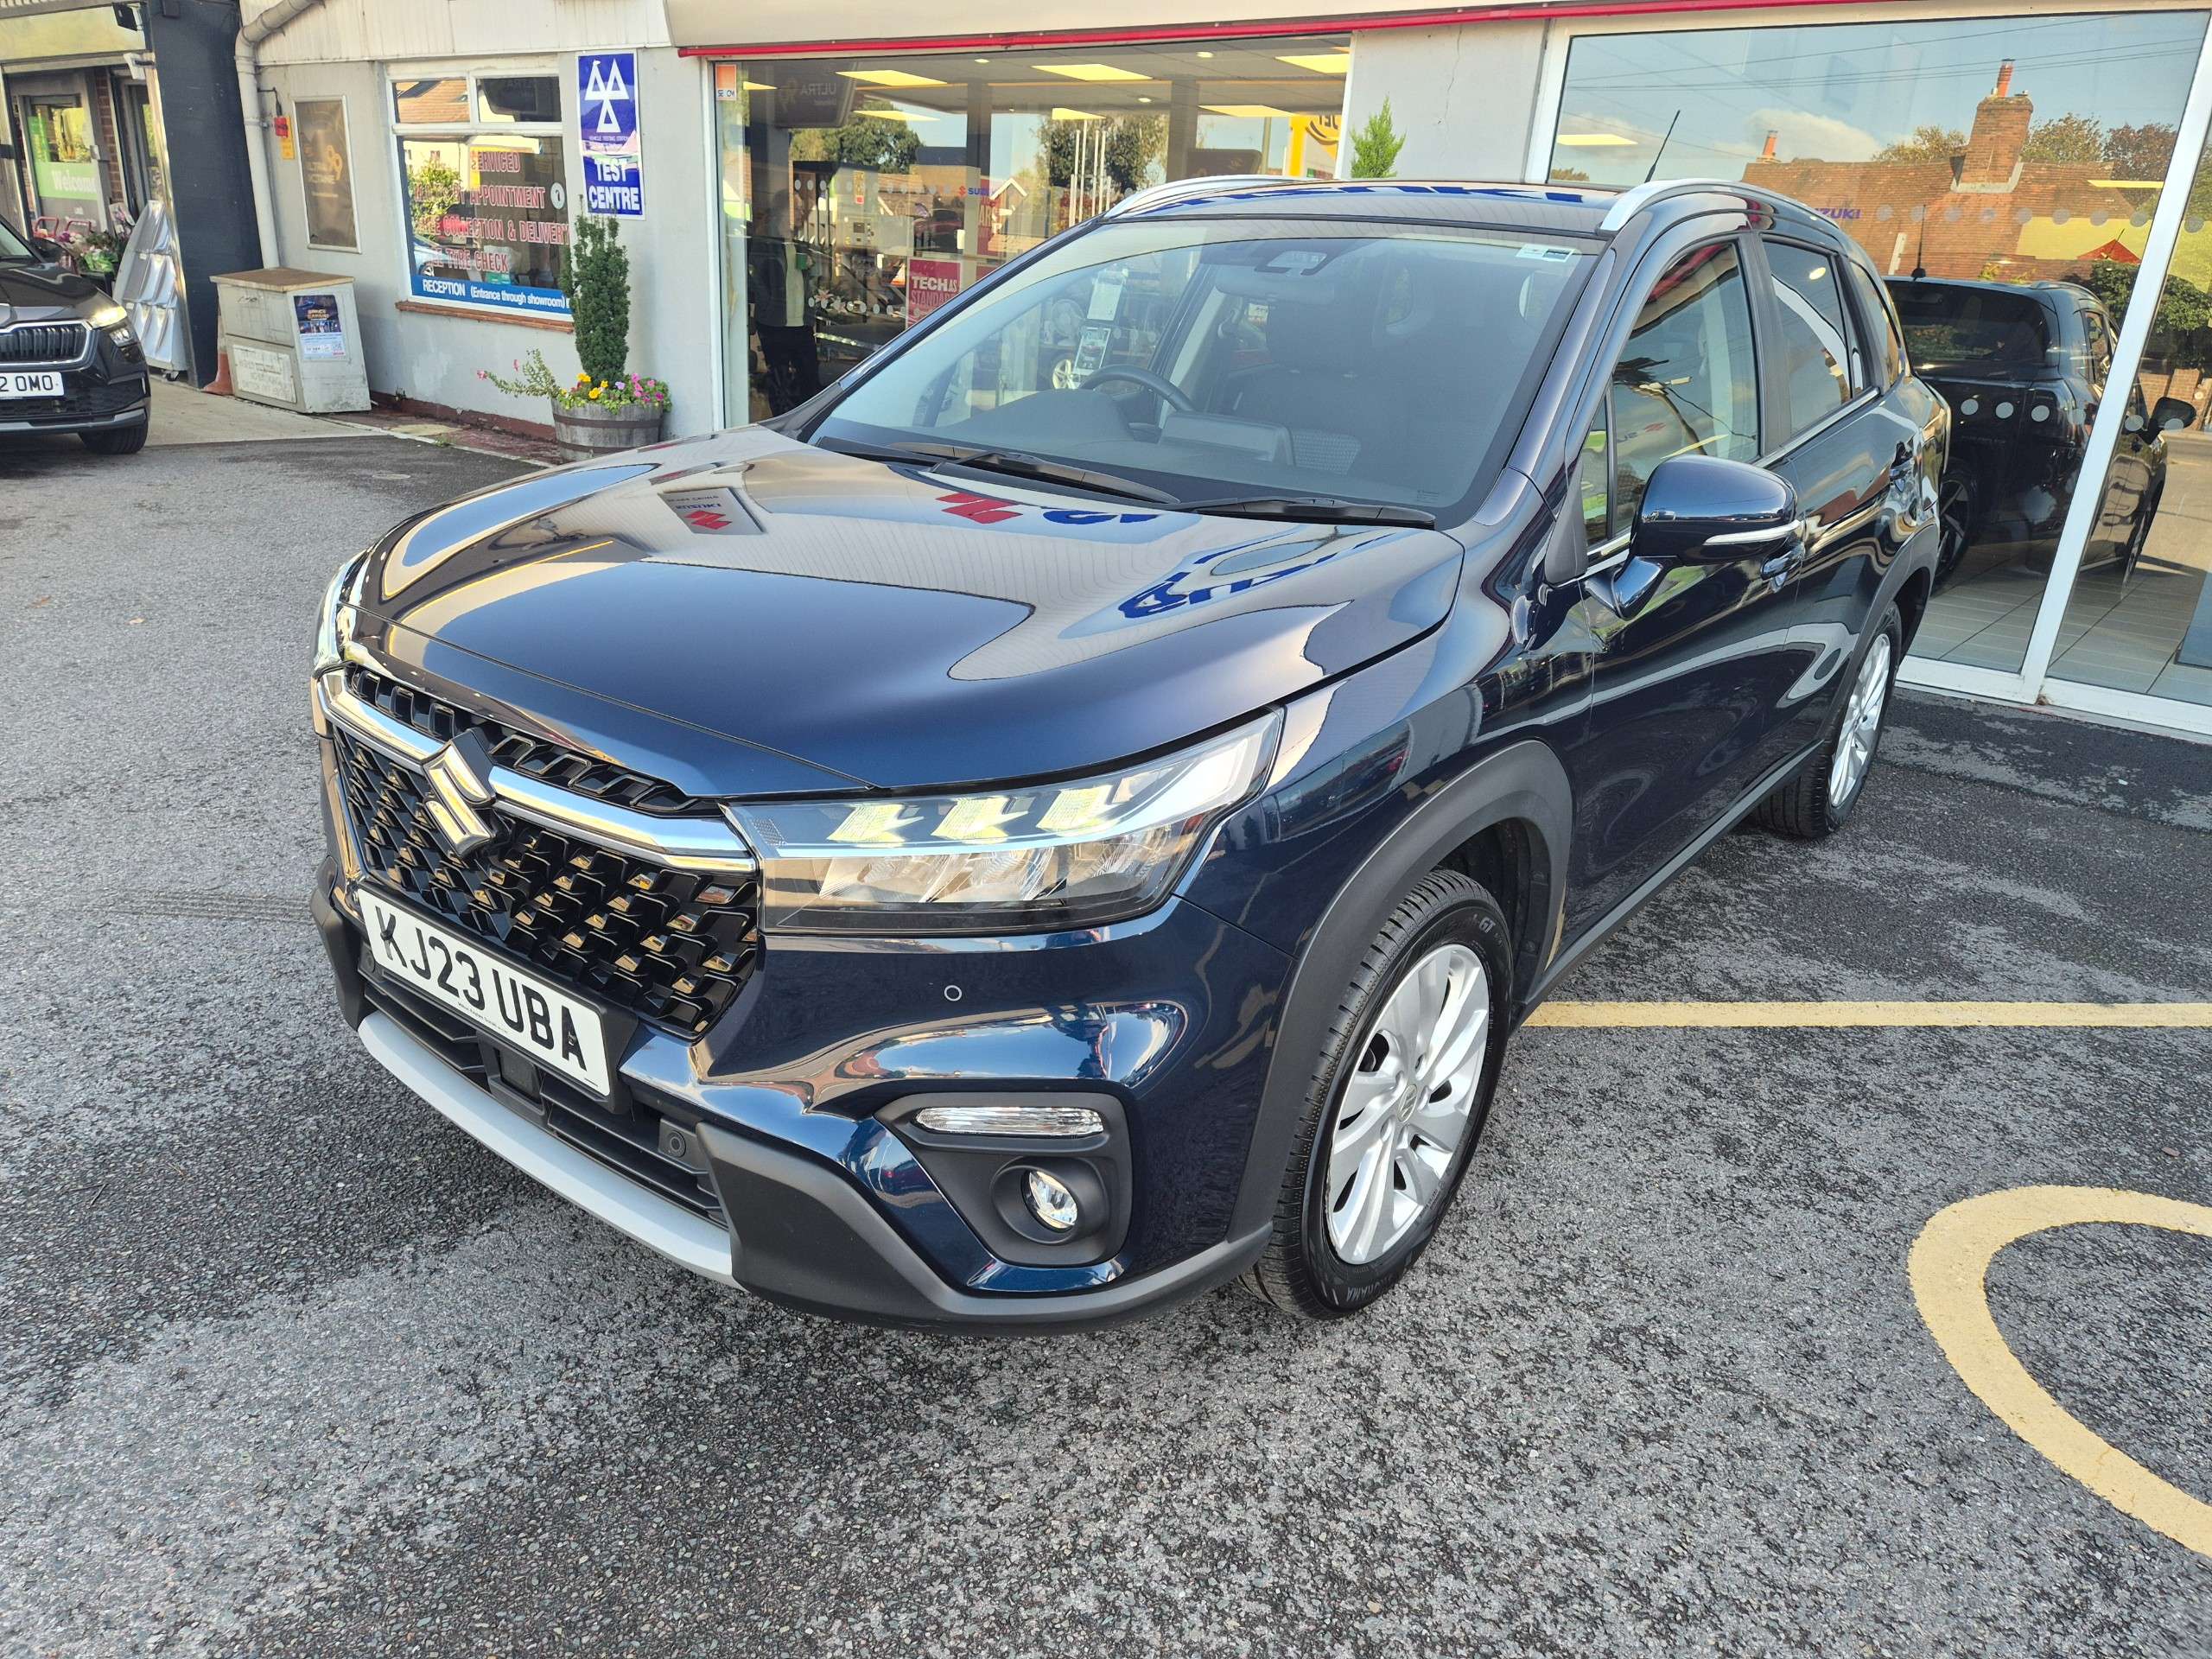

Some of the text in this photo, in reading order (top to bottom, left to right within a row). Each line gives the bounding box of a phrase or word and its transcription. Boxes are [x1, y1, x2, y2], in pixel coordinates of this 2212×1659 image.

[717, 89, 734, 98] SEOM
[594, 157, 627, 182] TEST
[469, 184, 546, 210] APPOINTMENT
[588, 185, 640, 210] CENTRE
[442, 217, 504, 241] COLLECTION
[508, 220, 517, 241] &
[519, 220, 570, 245] DELIVERY
[446, 248, 471, 270] TYRE
[474, 251, 510, 274] CHECK
[423, 279, 466, 296] RECEPTION
[470, 286, 501, 300] (Entrance
[501, 289, 526, 304] through
[527, 293, 565, 309] showroom)
[912, 276, 957, 293] TECH AS
[912, 289, 953, 308] STANDAR
[16, 375, 54, 391] OMO
[375, 905, 588, 1072] KJ23 UBA
